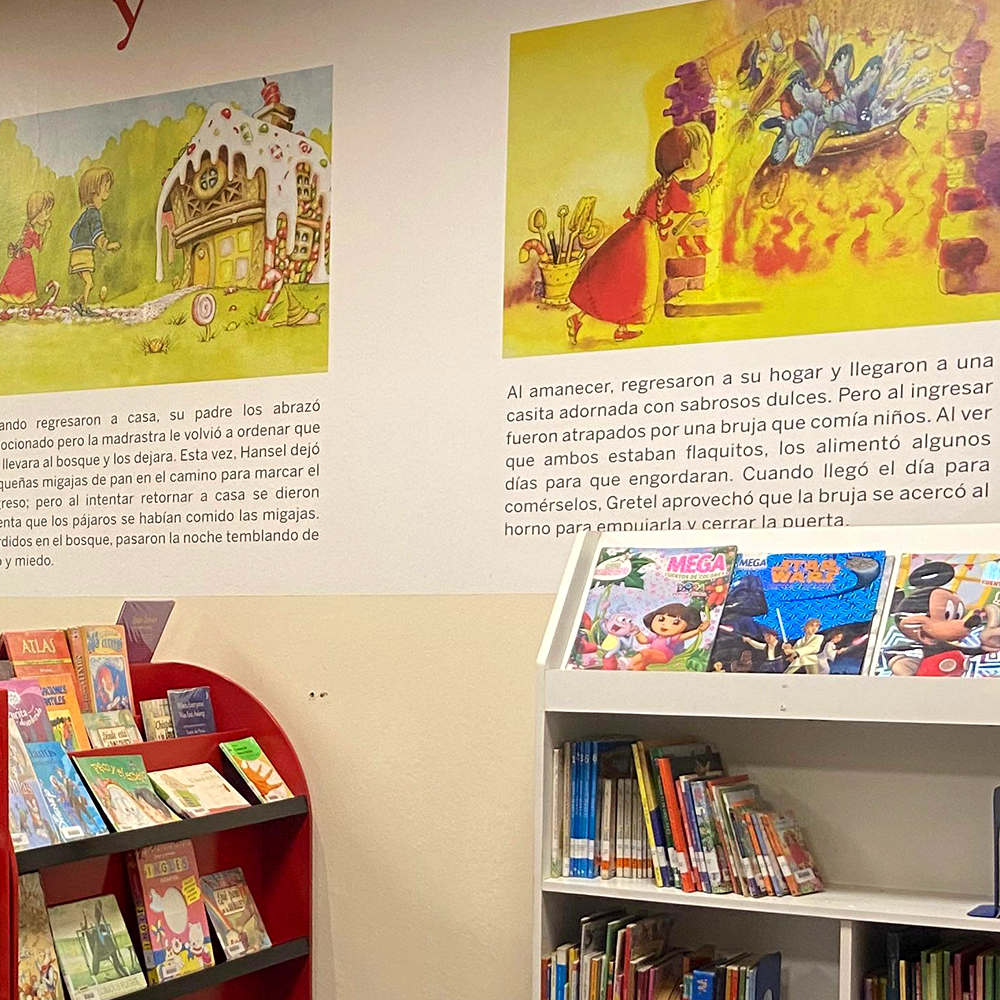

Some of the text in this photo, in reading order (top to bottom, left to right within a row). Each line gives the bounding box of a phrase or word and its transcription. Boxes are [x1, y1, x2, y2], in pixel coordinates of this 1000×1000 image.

[113, 0, 144, 51] y
[506, 356, 993, 399] Al amanecer, regresaron a su hogar y llegaron a una
[36, 416, 100, 431] regresaron
[110, 414, 117, 425] a
[127, 412, 159, 423] casa,
[169, 410, 184, 421] su
[195, 405, 232, 422] padre
[243, 403, 262, 416] los
[273, 399, 320, 414] abrazó
[505, 458, 989, 492] días para que engordaran. Cuando llegó el día para
[35, 497, 62, 510] pero
[68, 493, 78, 506] al
[85, 493, 134, 505] intentar
[141, 491, 193, 503] retornar
[200, 492, 207, 502] a
[214, 490, 245, 501] casa
[252, 489, 267, 500] se
[275, 486, 319, 499] dieron
[35, 537, 49, 546] en
[52, 533, 62, 546] el
[65, 534, 112, 547] bosque,
[115, 534, 165, 547] pasaron
[169, 531, 179, 544] la
[183, 530, 222, 543] noche
[226, 529, 298, 542] temblando
[302, 527, 319, 540] de
[666, 553, 767, 574] MEGA MEGA
[778, 559, 839, 574] STAR
[771, 570, 836, 583] WARS
[22, 637, 56, 654] ATLAS
